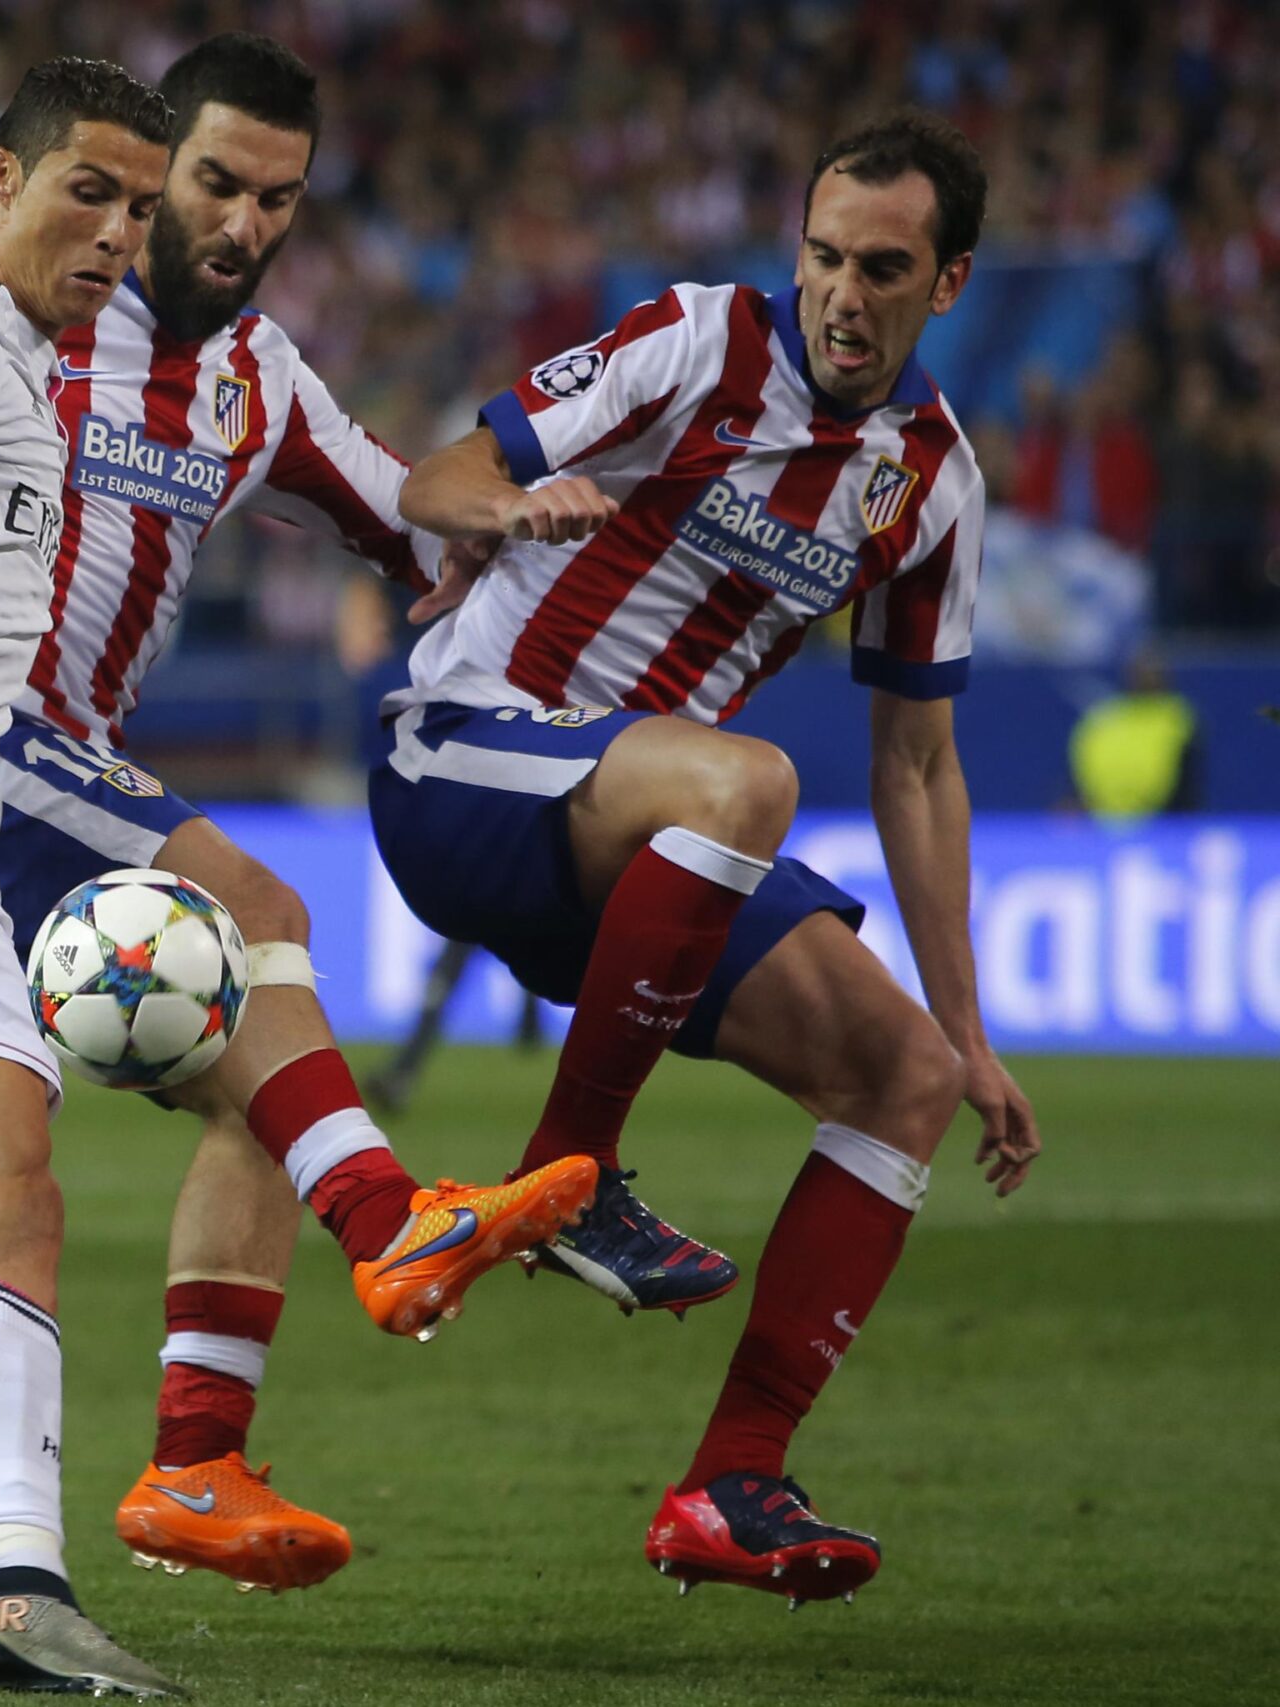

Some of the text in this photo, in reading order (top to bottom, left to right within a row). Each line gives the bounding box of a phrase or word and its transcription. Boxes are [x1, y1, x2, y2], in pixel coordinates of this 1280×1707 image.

[83, 421, 226, 500] Baku 2015
[107, 476, 179, 510] EUROPEAN
[180, 498, 216, 521] GAMES
[696, 482, 857, 589] Baku 2015
[708, 538, 791, 587] EUROPEAN
[790, 578, 837, 608] GAMES
[53, 947, 74, 977] adidas
